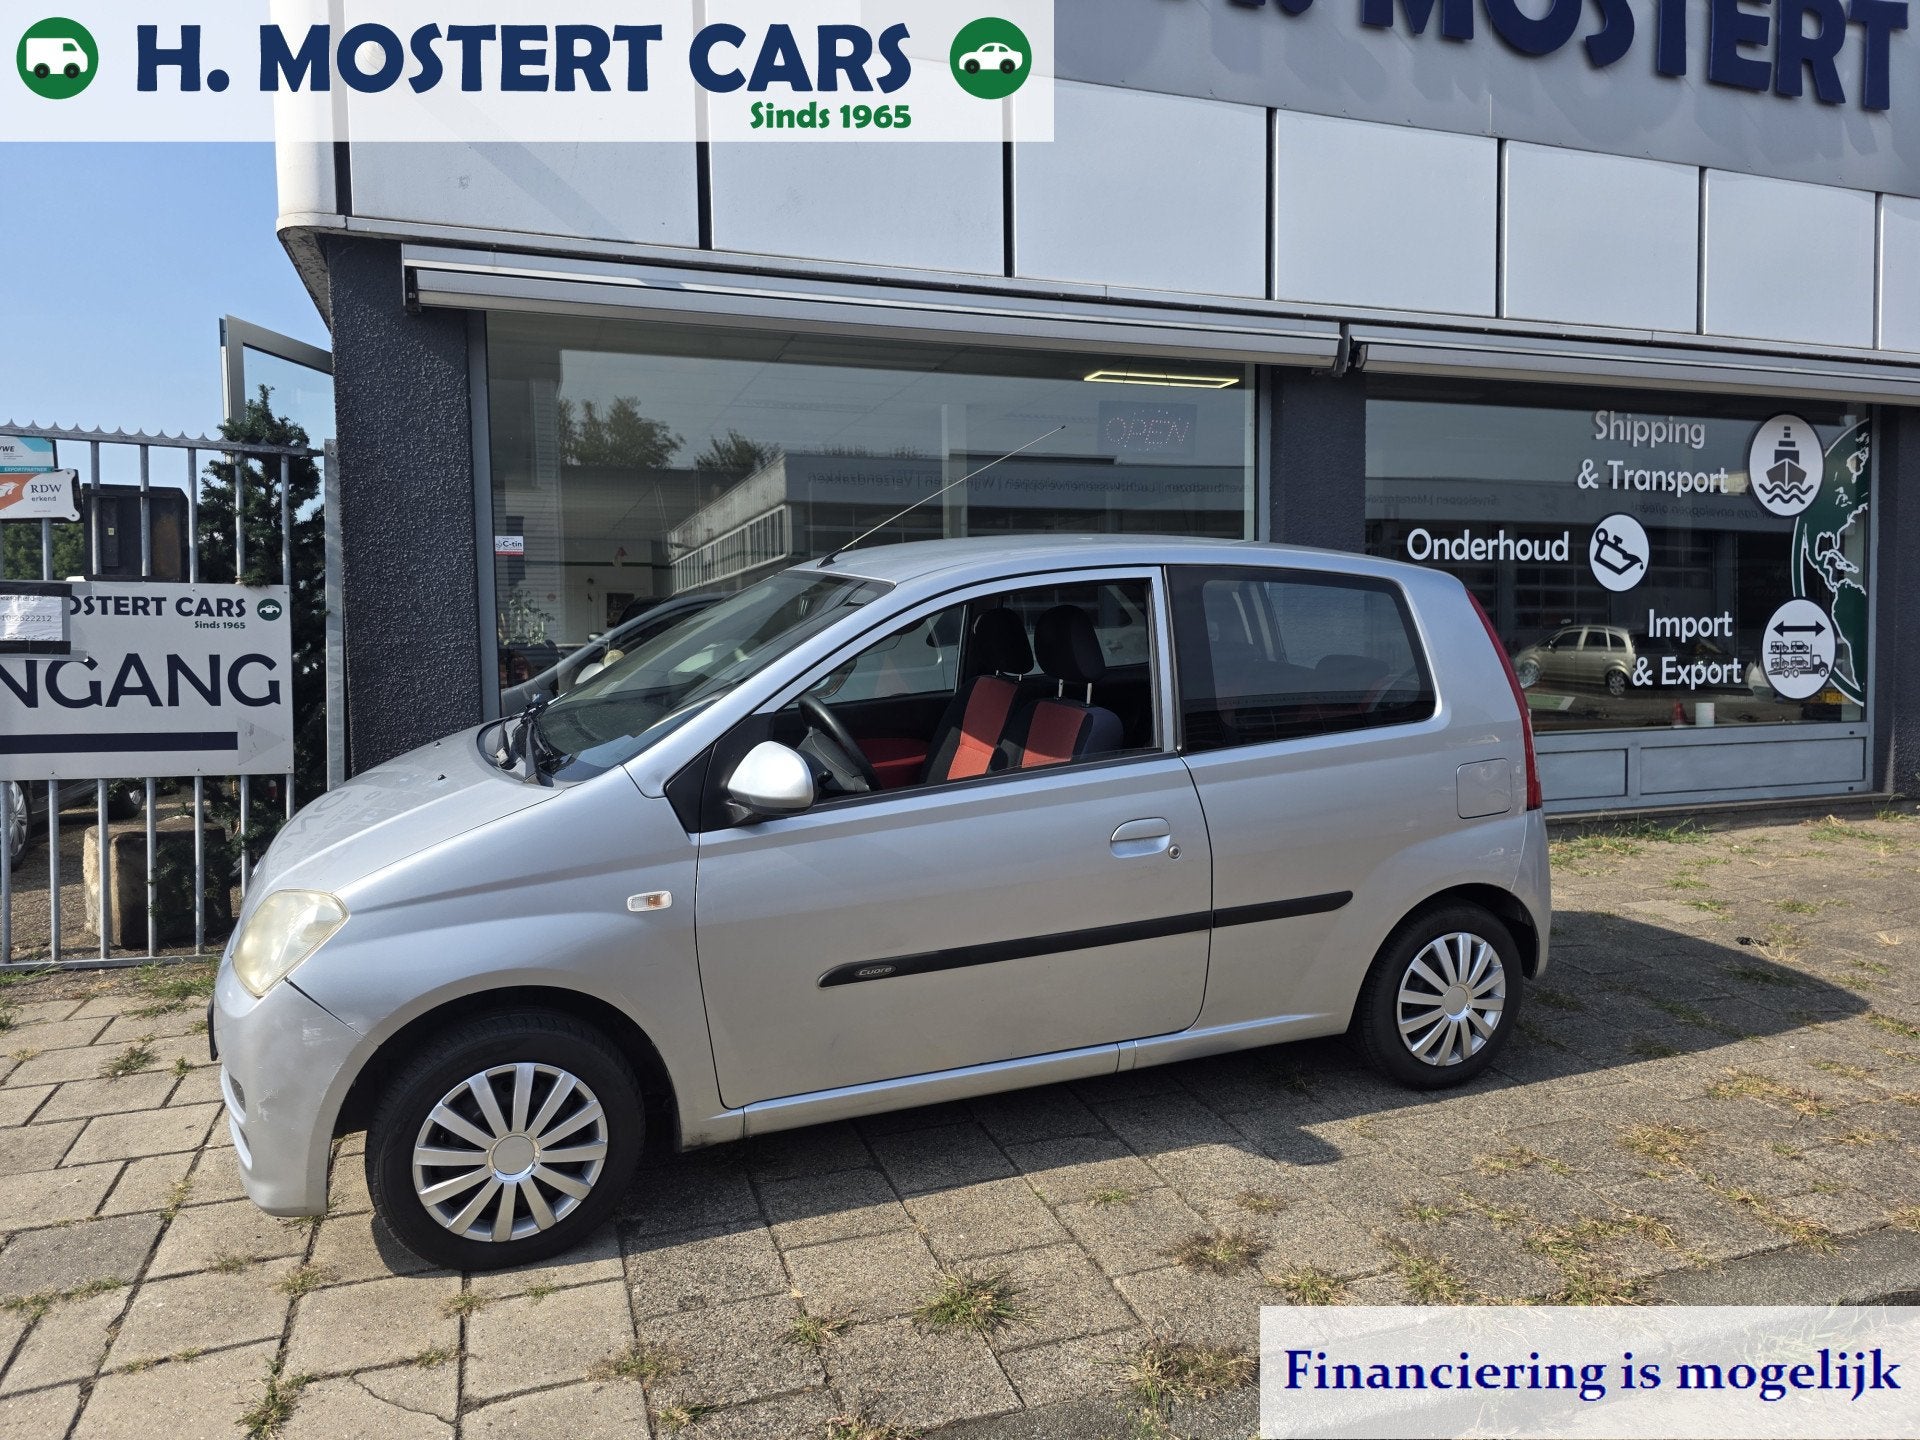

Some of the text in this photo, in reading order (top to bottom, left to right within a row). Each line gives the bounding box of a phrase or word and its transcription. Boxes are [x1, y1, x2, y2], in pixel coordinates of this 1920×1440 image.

[1361, 0, 1909, 111] OSTERT
[1105, 414, 1191, 448] OPEN
[1595, 410, 1706, 449] Shipping
[30, 484, 62, 494] RDW
[1577, 458, 1729, 498] & Transport
[1406, 528, 1570, 561] Onderhoud
[175, 596, 246, 618] CARS
[194, 620, 246, 630] Sinds 1965
[1648, 608, 1733, 643] Import
[1632, 656, 1742, 691] & Export
[858, 966, 894, 977] Cuore
